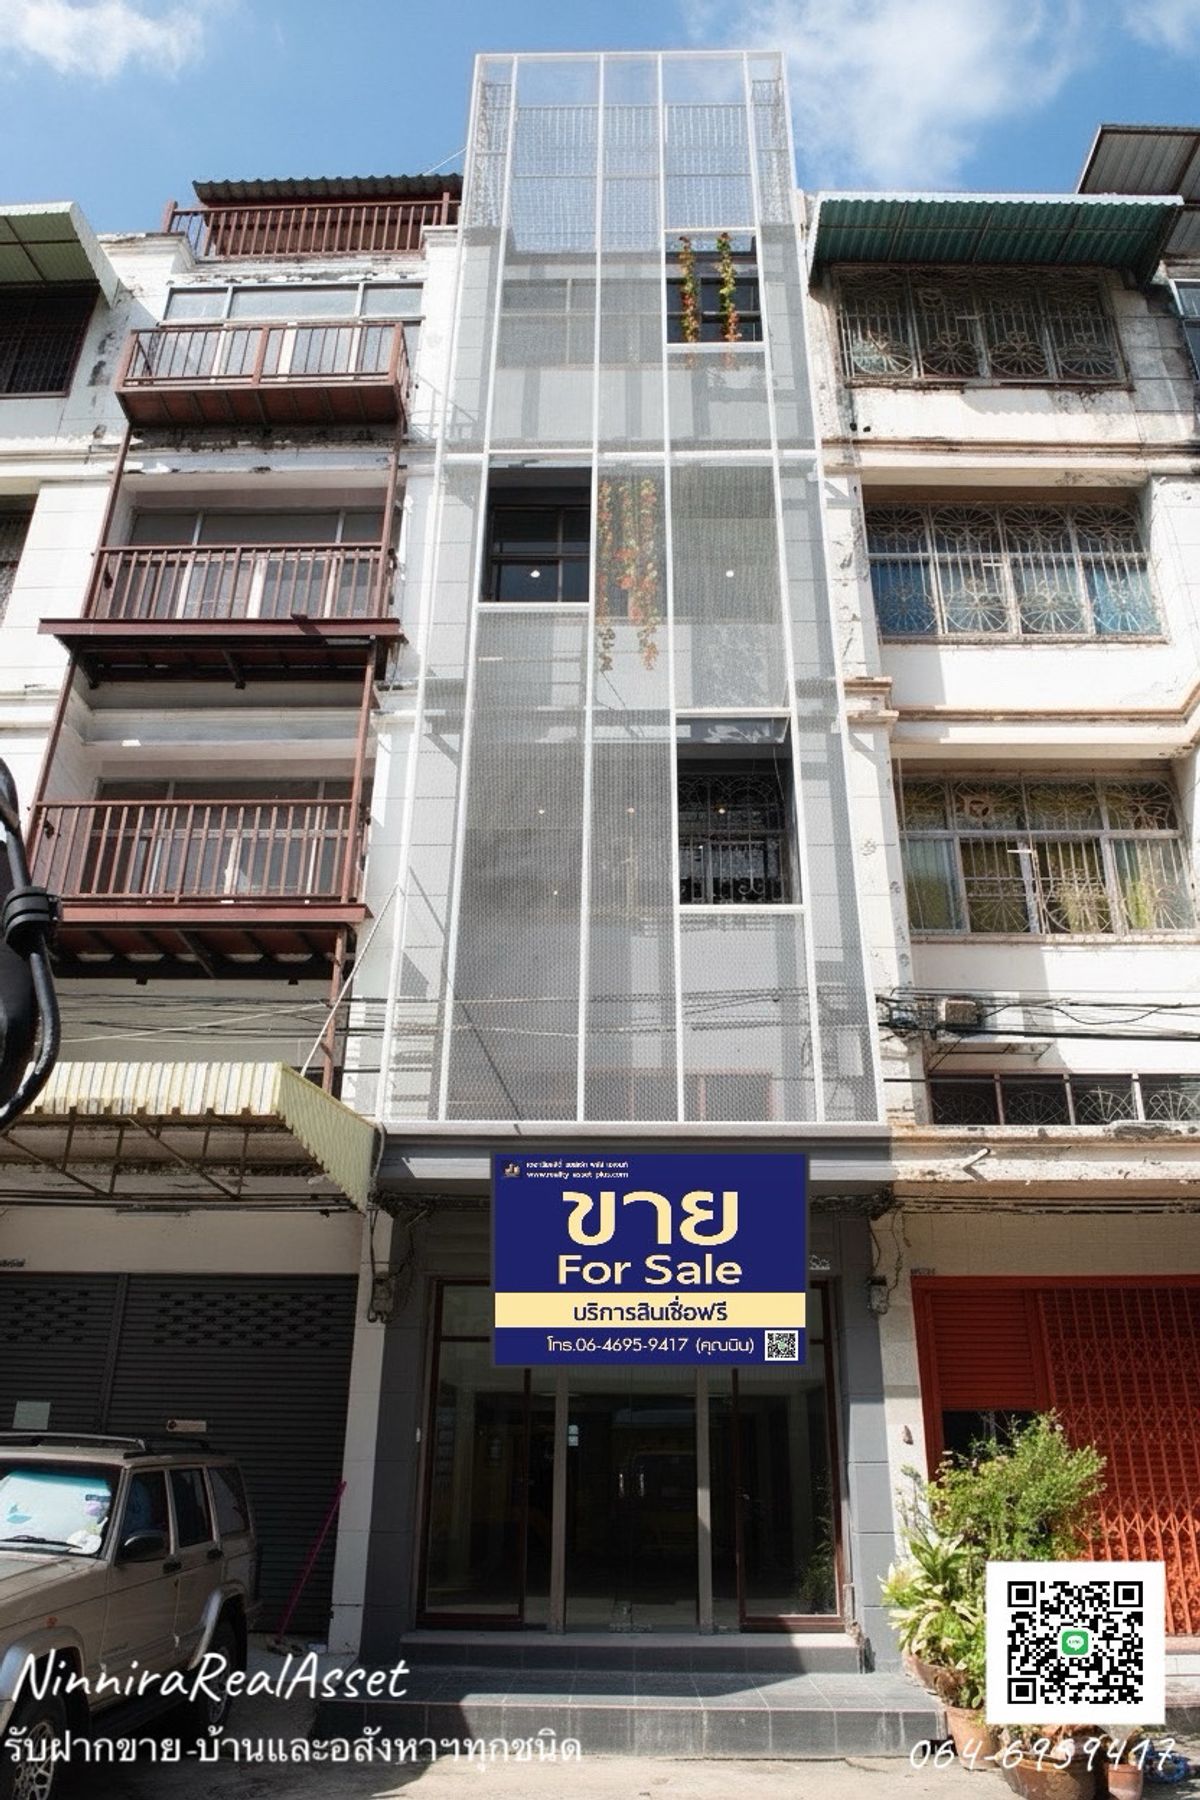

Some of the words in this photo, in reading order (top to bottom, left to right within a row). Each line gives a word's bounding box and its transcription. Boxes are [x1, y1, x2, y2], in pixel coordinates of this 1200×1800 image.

[562, 1190, 739, 1247] ขาย
[558, 1254, 632, 1285] For
[644, 1253, 743, 1285] Sale
[573, 1295, 728, 1321] บริการสินเชื่อฟรี
[546, 1335, 689, 1353] โทร.06-4695-9417
